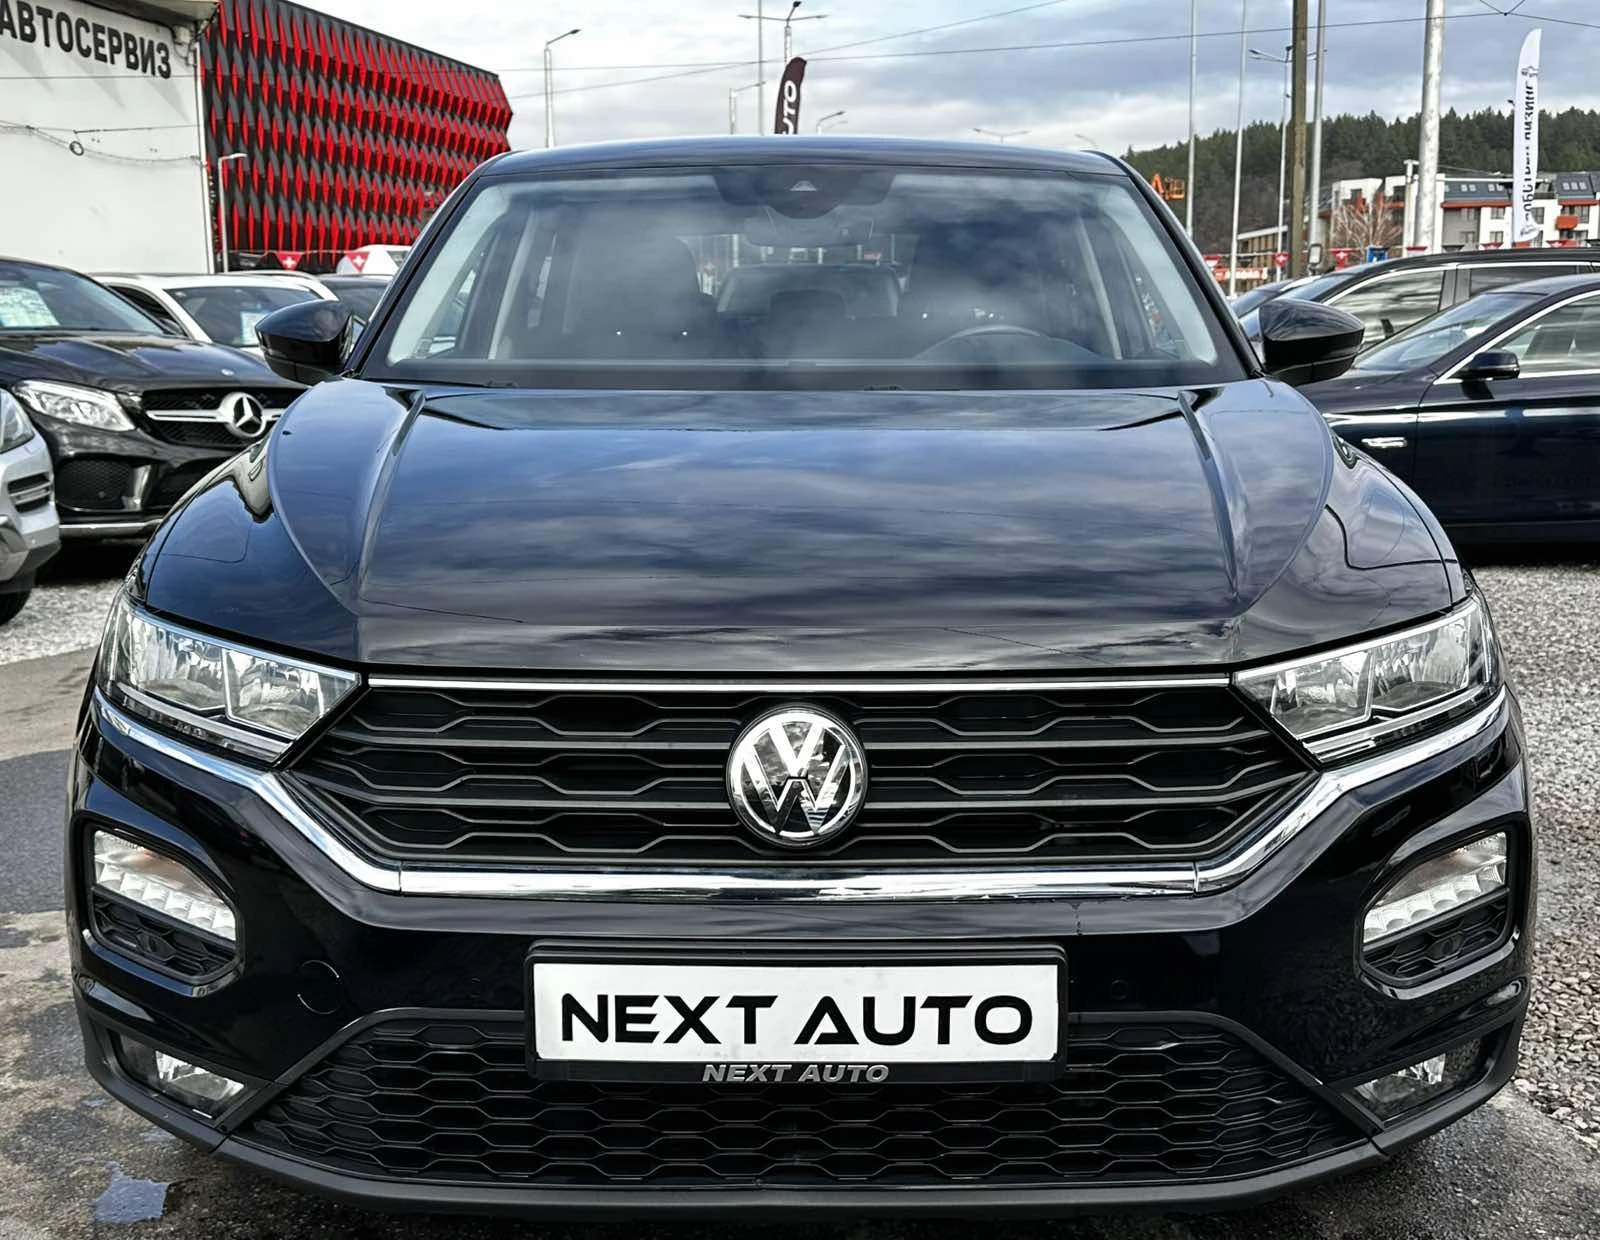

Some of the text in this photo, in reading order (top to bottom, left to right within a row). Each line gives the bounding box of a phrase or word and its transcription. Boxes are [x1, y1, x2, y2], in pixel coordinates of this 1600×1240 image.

[0, 0, 172, 79] АВТОСЕРВИЗ
[730, 710, 865, 841] VW
[562, 993, 1033, 1045] NEXT AUTO
[702, 1064, 889, 1083] NEXT AUTO
